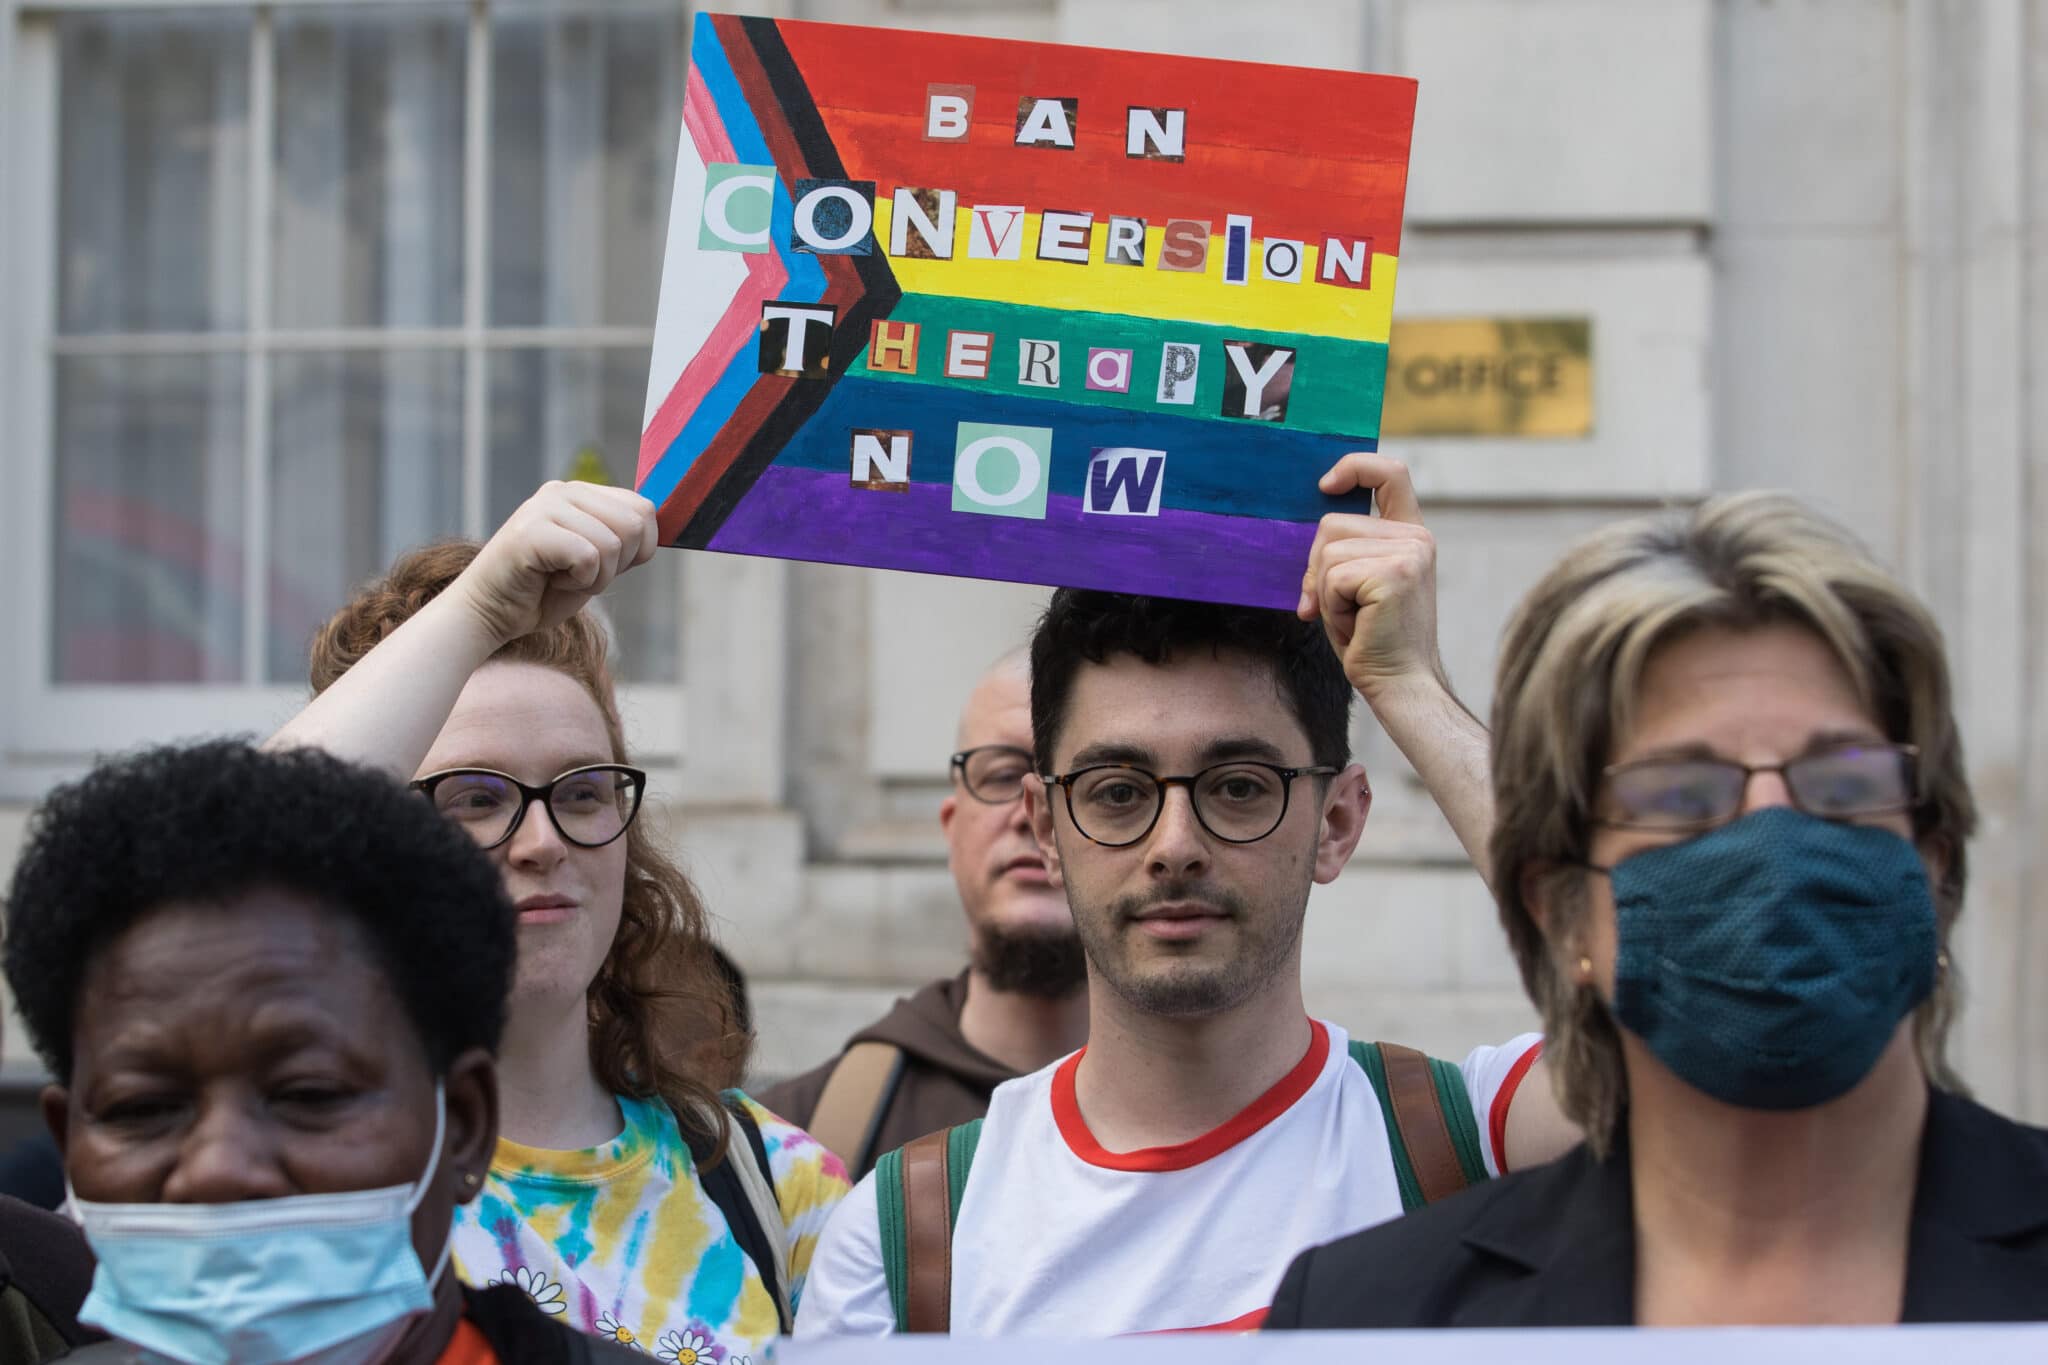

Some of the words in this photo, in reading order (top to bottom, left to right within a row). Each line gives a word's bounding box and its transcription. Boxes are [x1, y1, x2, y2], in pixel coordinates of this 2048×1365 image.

[926, 95, 1186, 157] BAN
[1402, 355, 1563, 399] OFFICE
[851, 435, 1163, 514] NOW
